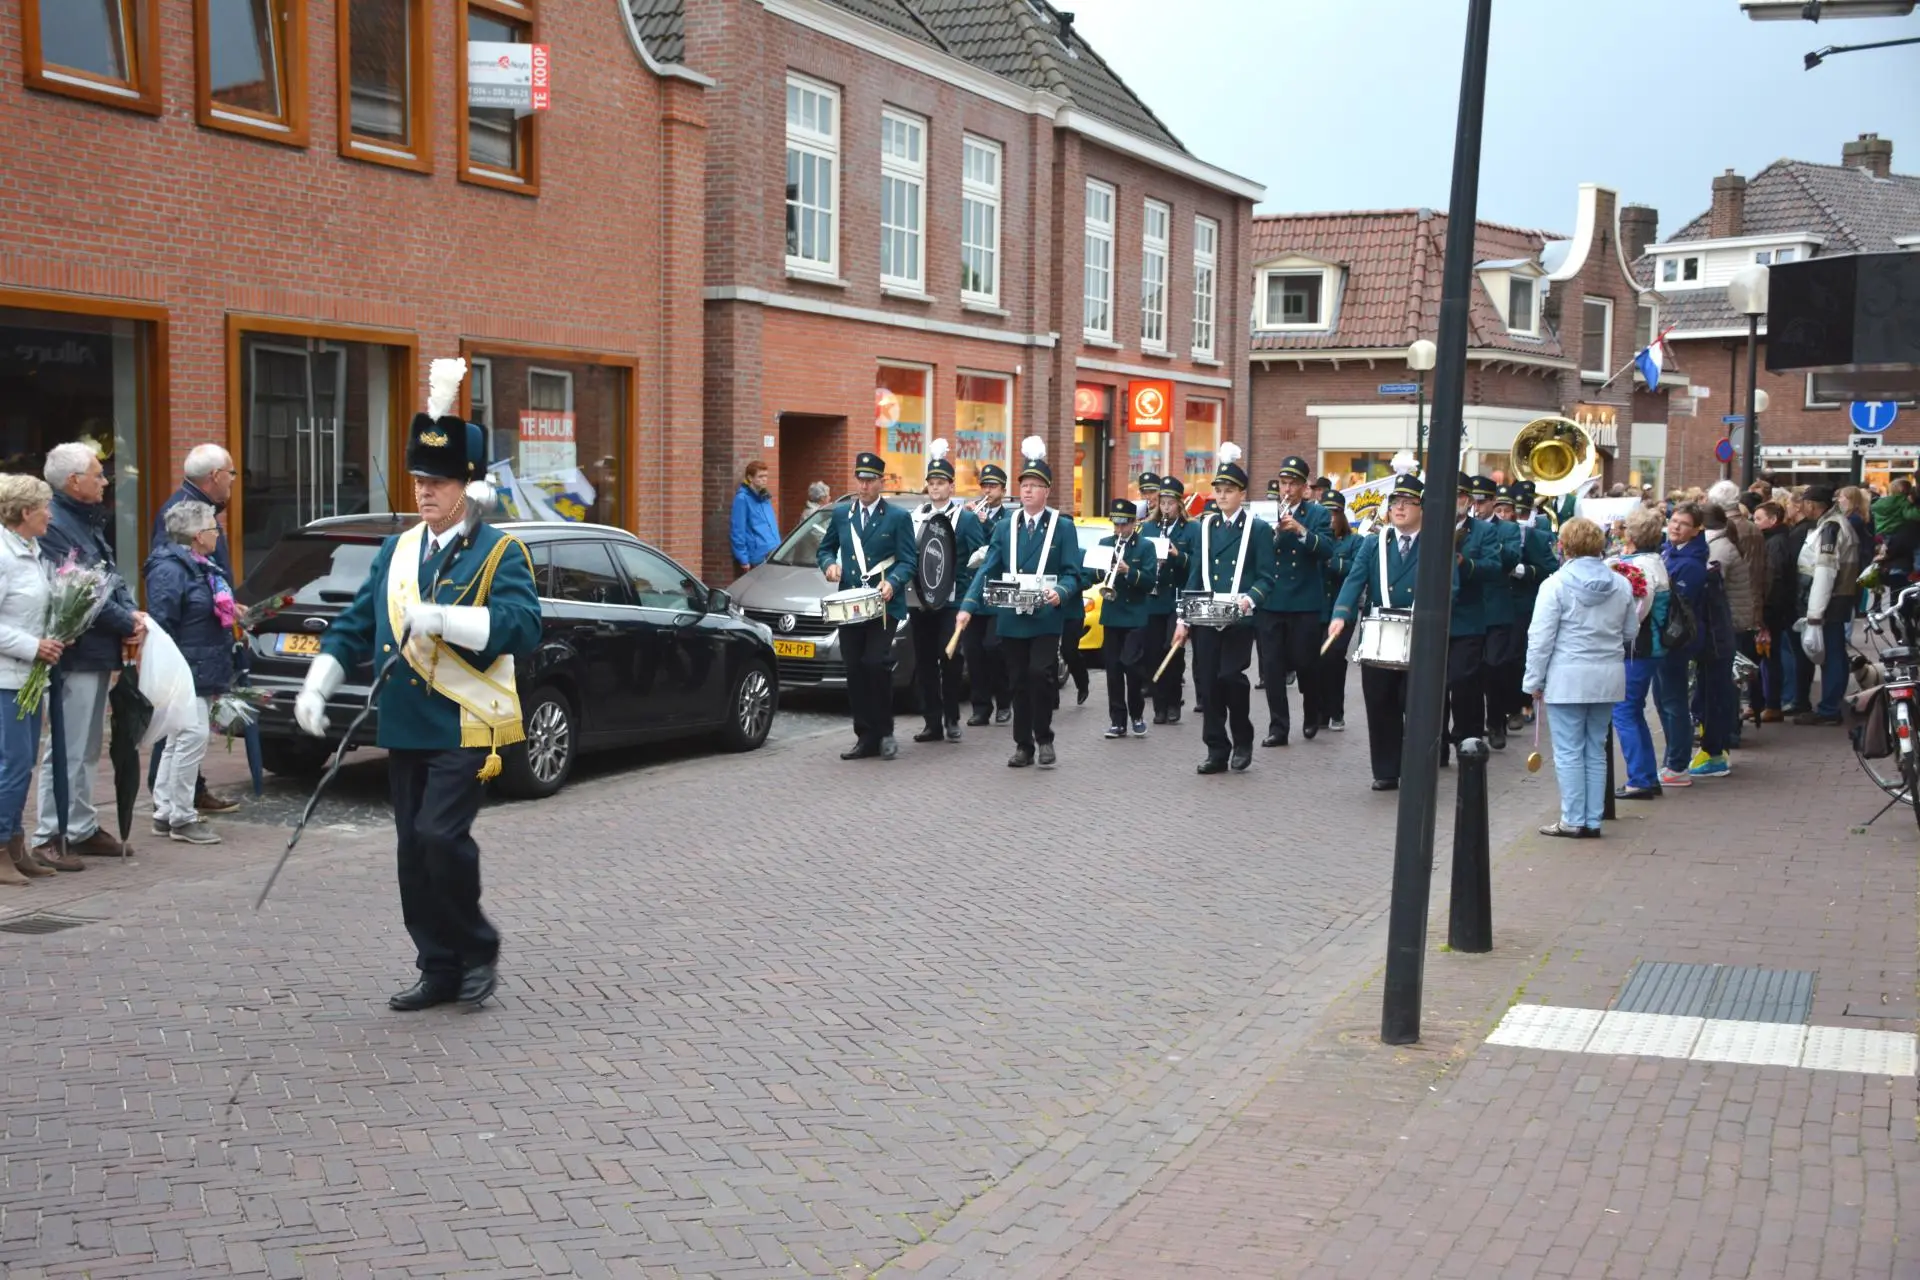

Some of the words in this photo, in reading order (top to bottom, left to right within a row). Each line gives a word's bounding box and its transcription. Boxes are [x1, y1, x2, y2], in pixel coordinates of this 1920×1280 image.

[534, 47, 547, 88] KOOP
[534, 92, 547, 109] TE
[521, 417, 536, 436] TE
[539, 417, 573, 437] HUUR
